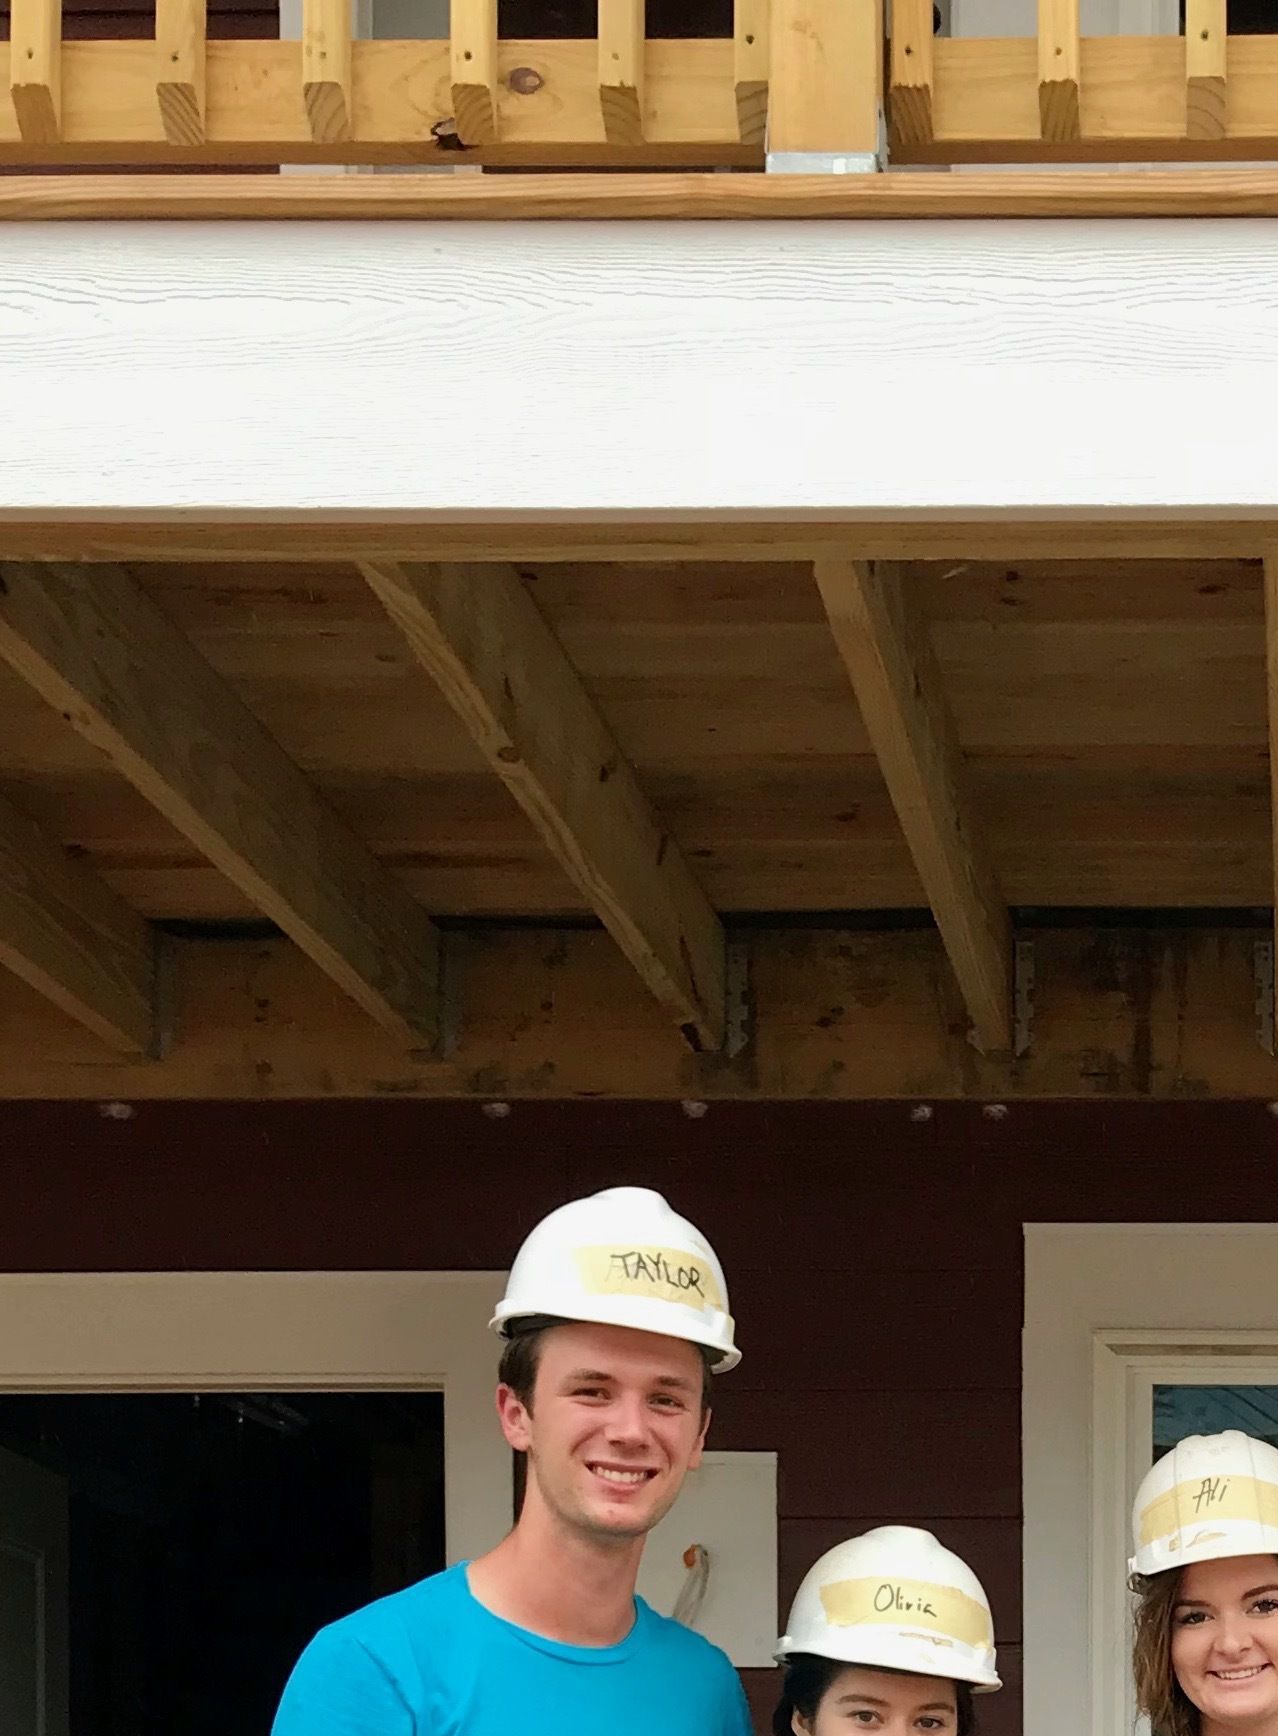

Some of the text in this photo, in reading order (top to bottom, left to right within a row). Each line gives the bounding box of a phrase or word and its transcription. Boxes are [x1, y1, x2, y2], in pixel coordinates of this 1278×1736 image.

[610, 1251, 705, 1299] TAYLOR
[1192, 1477, 1231, 1514] Ali
[873, 1583, 938, 1618] Olivia
